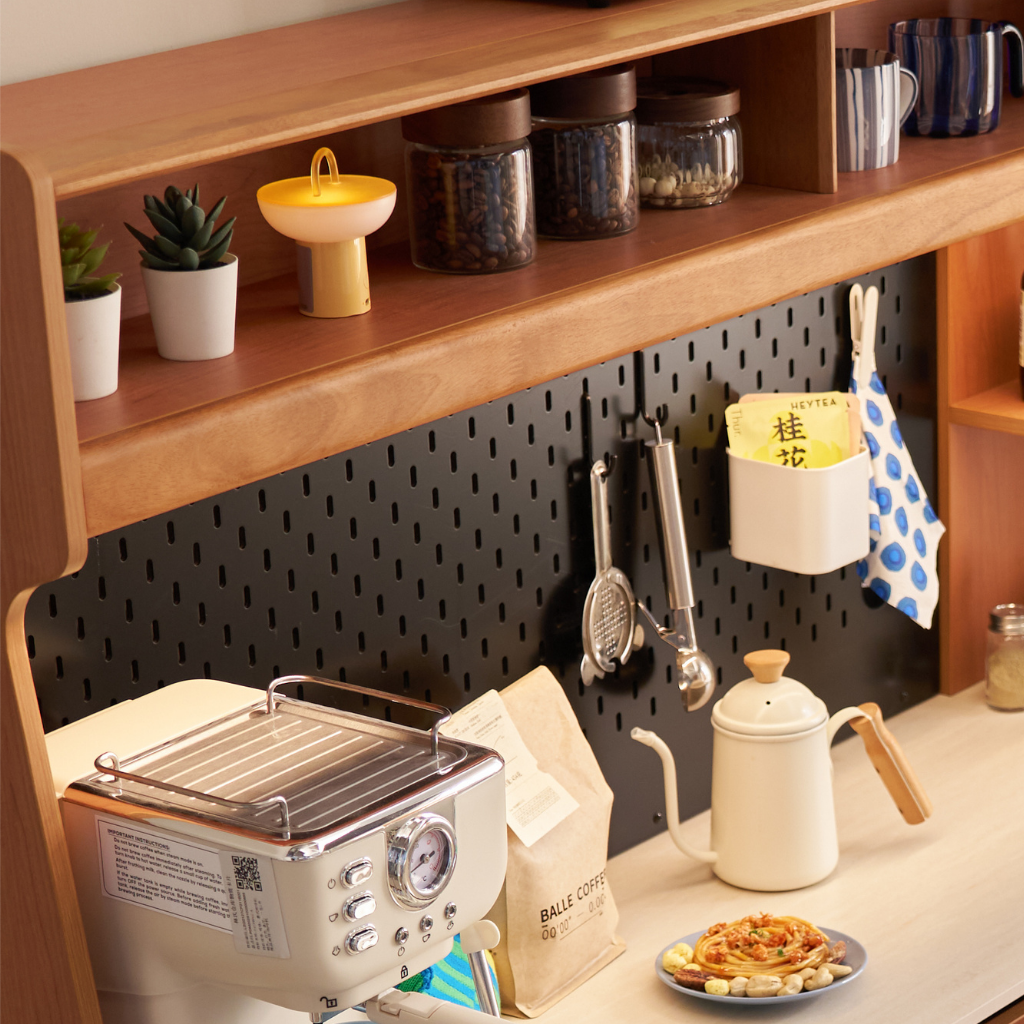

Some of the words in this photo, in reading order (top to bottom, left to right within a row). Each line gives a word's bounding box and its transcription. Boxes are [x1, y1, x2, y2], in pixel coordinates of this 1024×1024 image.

[791, 398, 837, 410] HEYTEA
[540, 893, 573, 923] BALLE
[577, 868, 606, 900] COFFE
